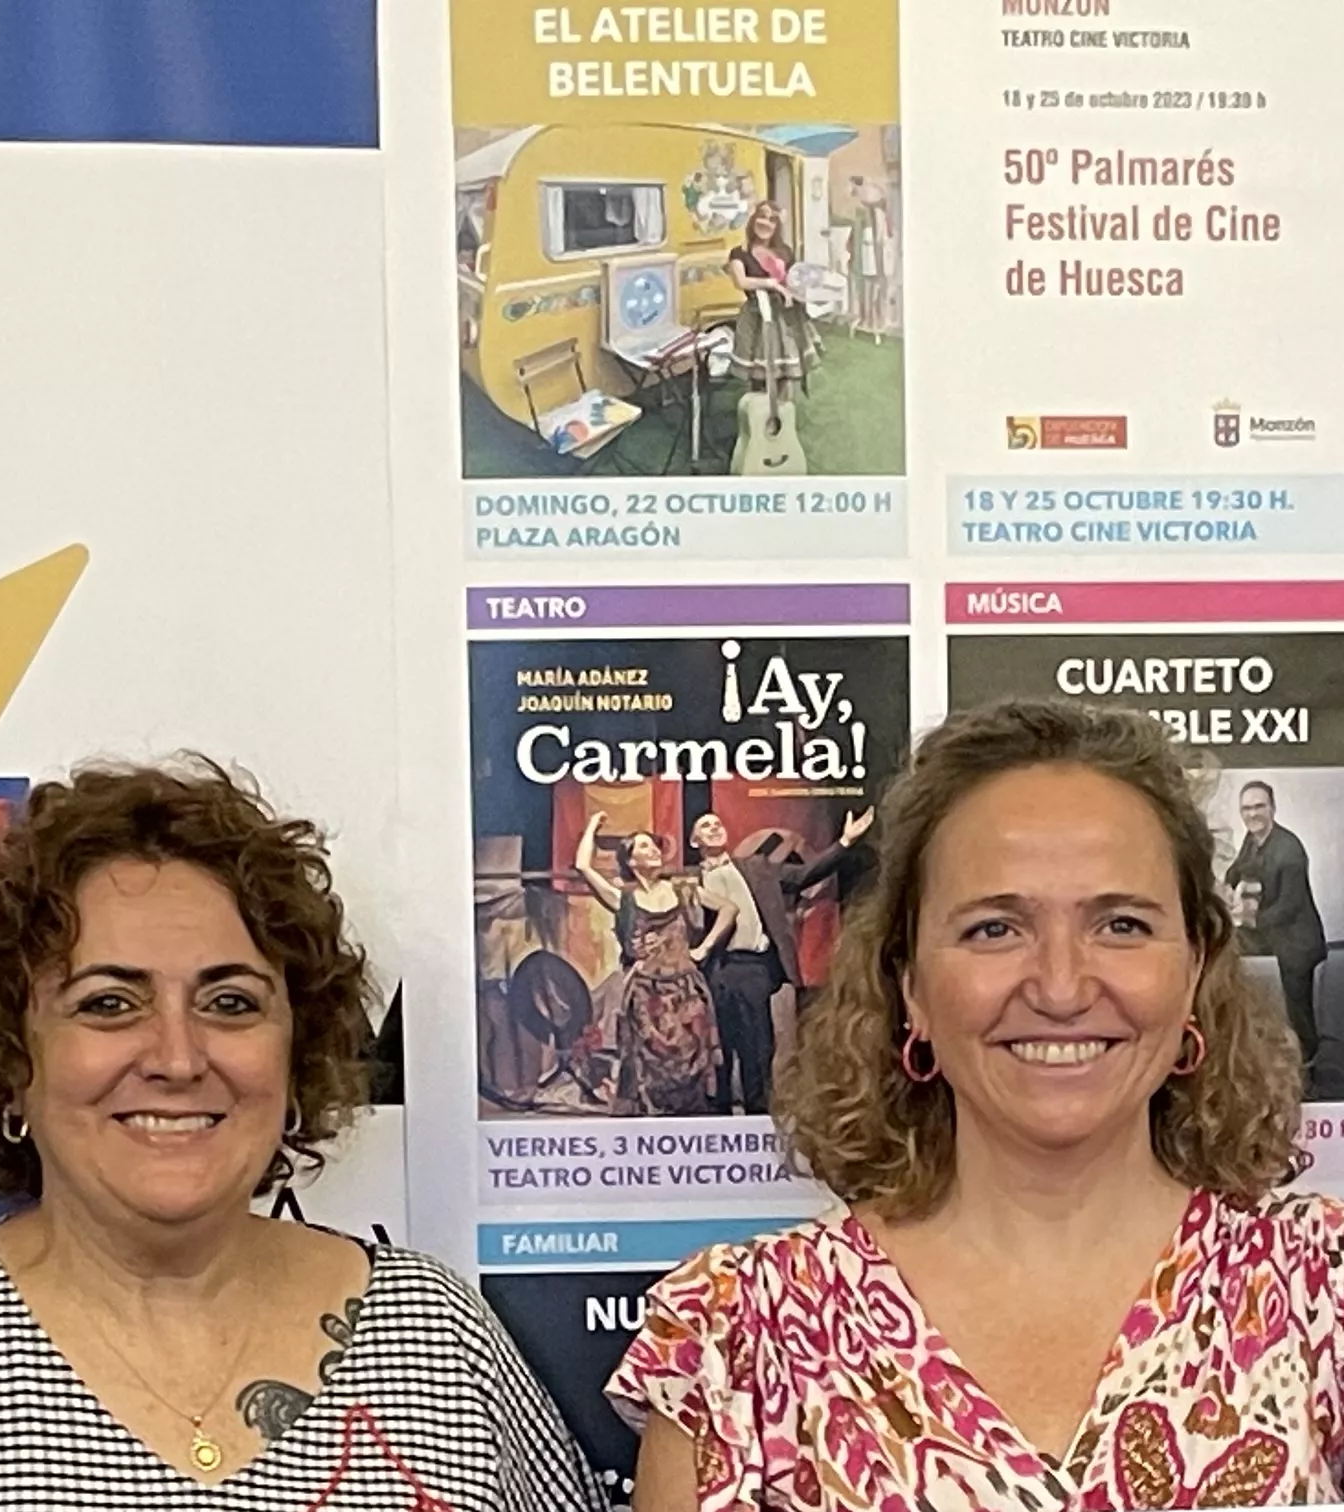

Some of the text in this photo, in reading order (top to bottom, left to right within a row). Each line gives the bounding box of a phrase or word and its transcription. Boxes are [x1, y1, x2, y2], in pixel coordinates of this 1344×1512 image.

[534, 7, 827, 44] EL ATELIER DE
[1002, 29, 1190, 48] TEATRO CINE VICTORIA
[549, 61, 815, 97] BELENTUELA
[1065, 91, 1084, 107] de
[1089, 91, 1148, 108] octubre
[1153, 92, 1192, 108] 2023
[1072, 148, 1234, 186] Palmarés
[1006, 204, 1281, 242] Festival de Cine
[1006, 261, 1184, 296] de Huesca
[476, 493, 892, 518] DOMINGO, 22 OCTUBRE 12:00 H
[964, 490, 1295, 511] 18 Y 25 OCTUBRE 19:30 H.
[477, 519, 680, 547] PLAZA ARAGÓN
[963, 520, 1257, 543] TEATRO CINE VICTORIA
[487, 597, 586, 618] TEATRO
[968, 588, 1062, 614] MÚSICA
[517, 665, 647, 688] MARÍA ADÁNEZ
[1057, 658, 1273, 694] CUARTETO
[517, 691, 672, 713] JOAQUÍN NOTARIO
[1241, 708, 1308, 743] XXI
[517, 722, 866, 784] Carmela!
[488, 1136, 605, 1161] VIERNES,
[612, 1136, 627, 1155] 3
[489, 1162, 792, 1189] TEATRO CINE VICTORIA
[502, 1232, 619, 1255] FAMILIAR
